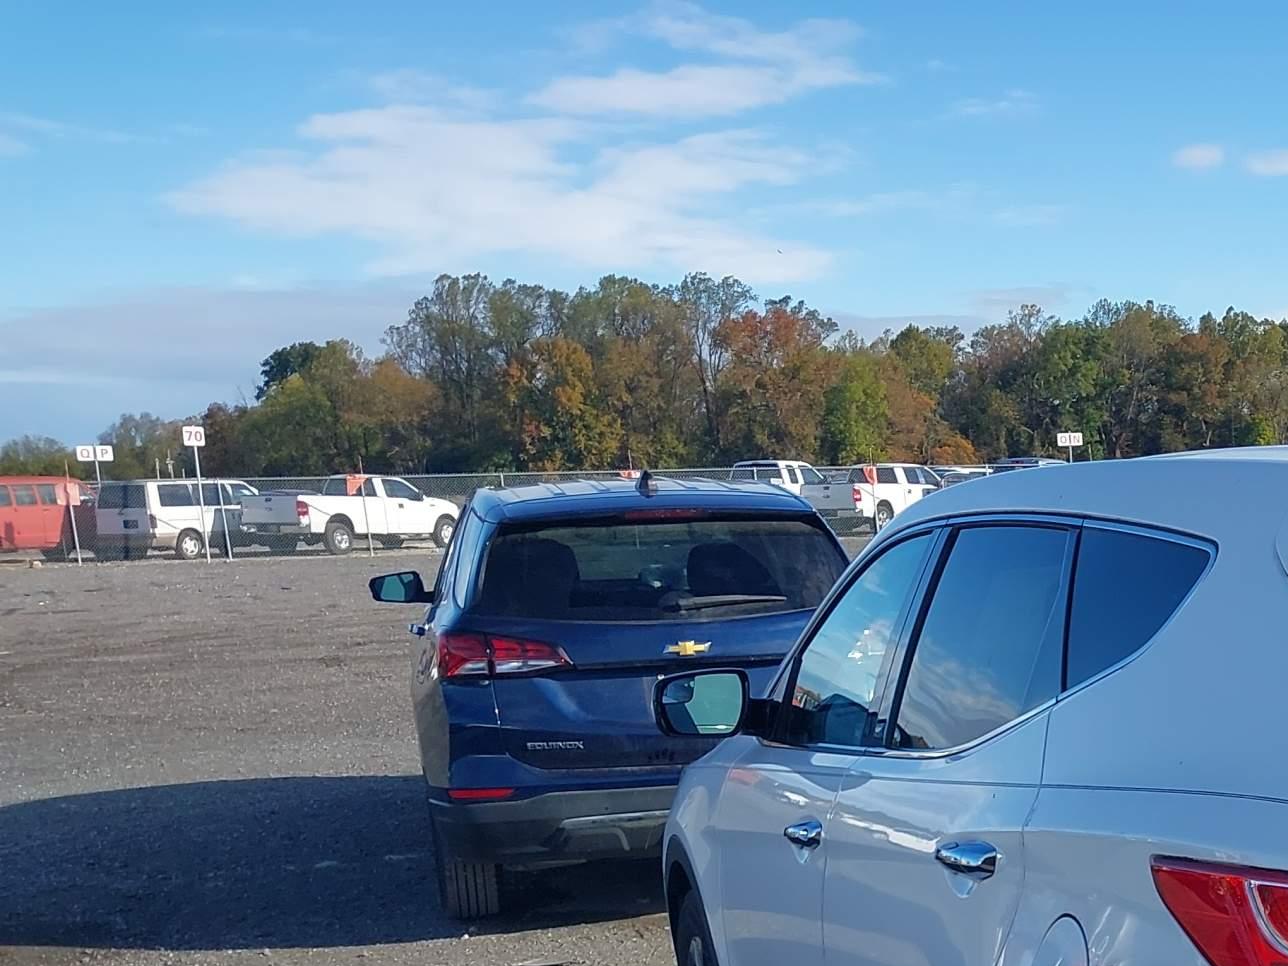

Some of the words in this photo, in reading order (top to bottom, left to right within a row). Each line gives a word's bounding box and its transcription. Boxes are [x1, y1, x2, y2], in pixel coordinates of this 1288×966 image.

[185, 430, 203, 443] 70
[80, 448, 90, 459] Q
[101, 448, 109, 459] P
[526, 741, 584, 750] EQUINOX
